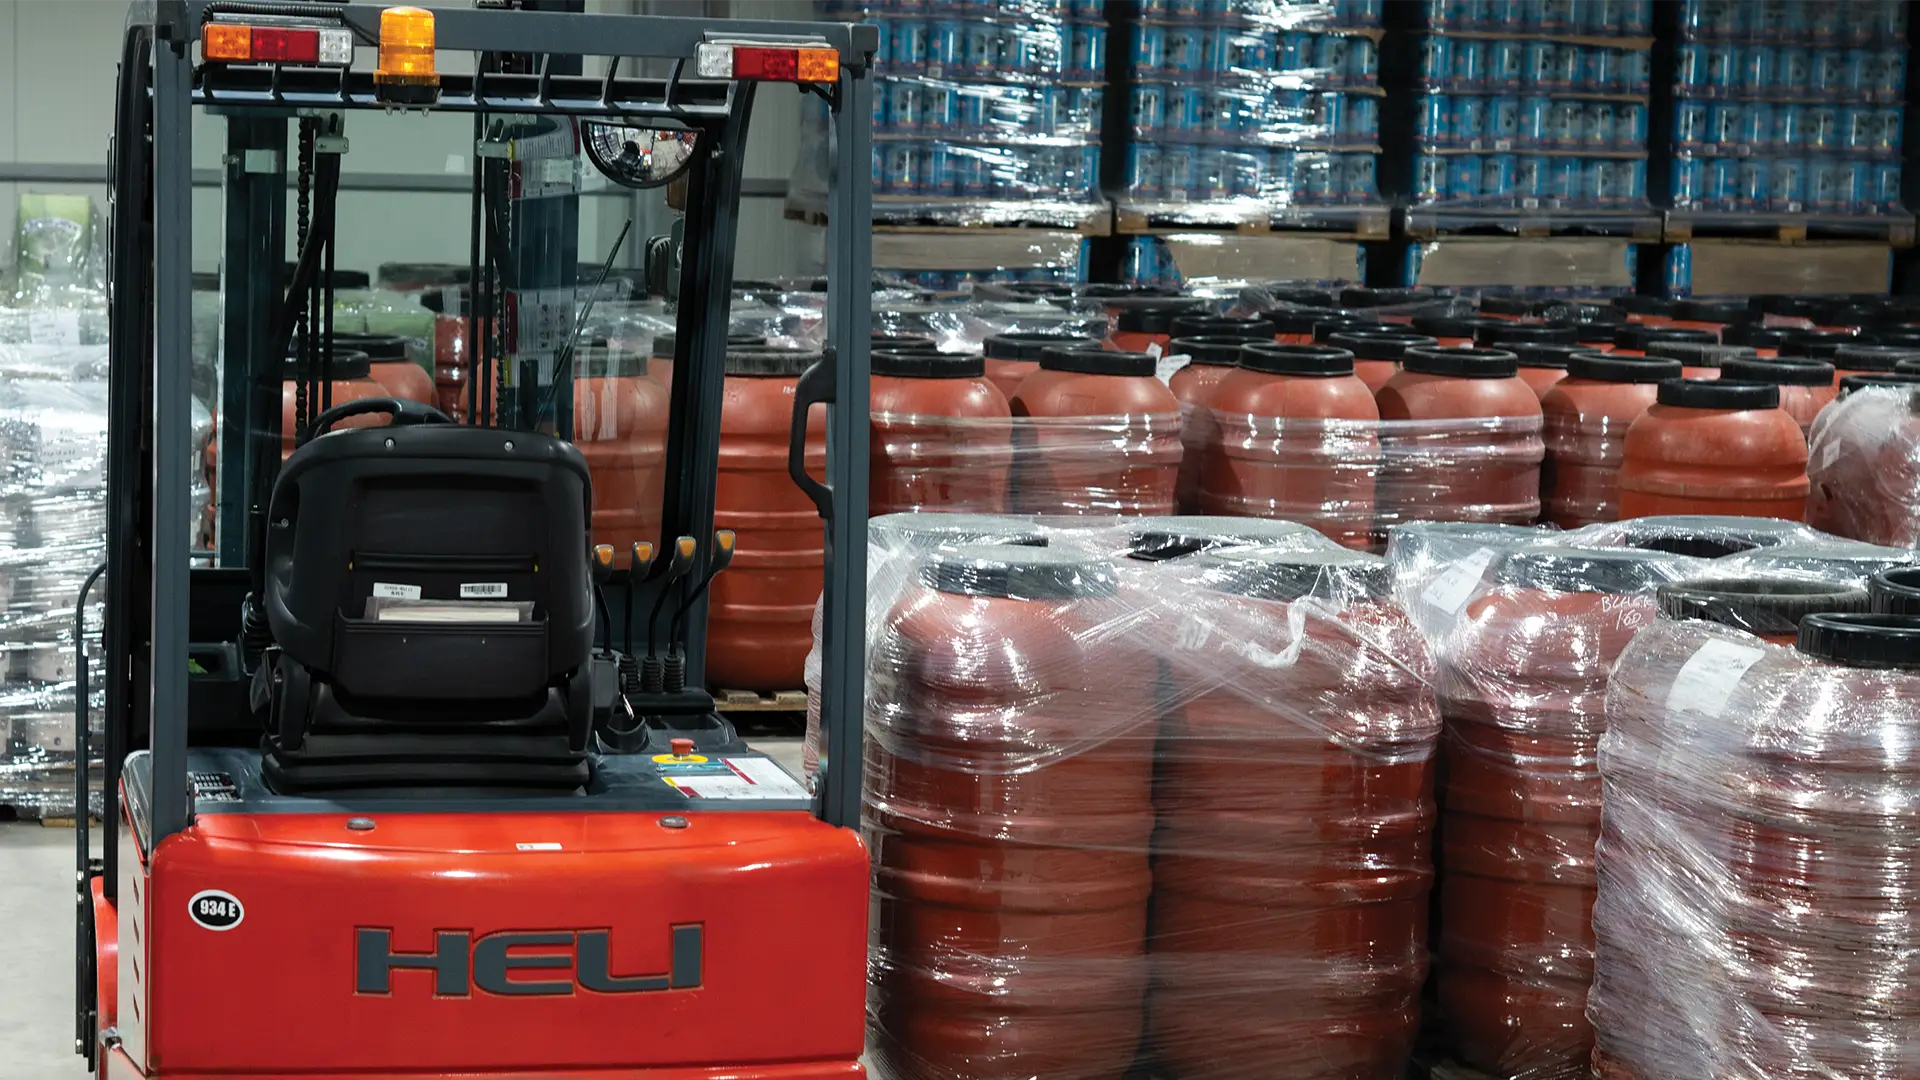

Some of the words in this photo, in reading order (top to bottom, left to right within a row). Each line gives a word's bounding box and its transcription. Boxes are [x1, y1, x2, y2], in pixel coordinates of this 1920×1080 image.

[1616, 609, 1642, 630] 160
[200, 899, 226, 917] 934
[228, 902, 236, 918] E
[353, 920, 705, 1000] HELI
